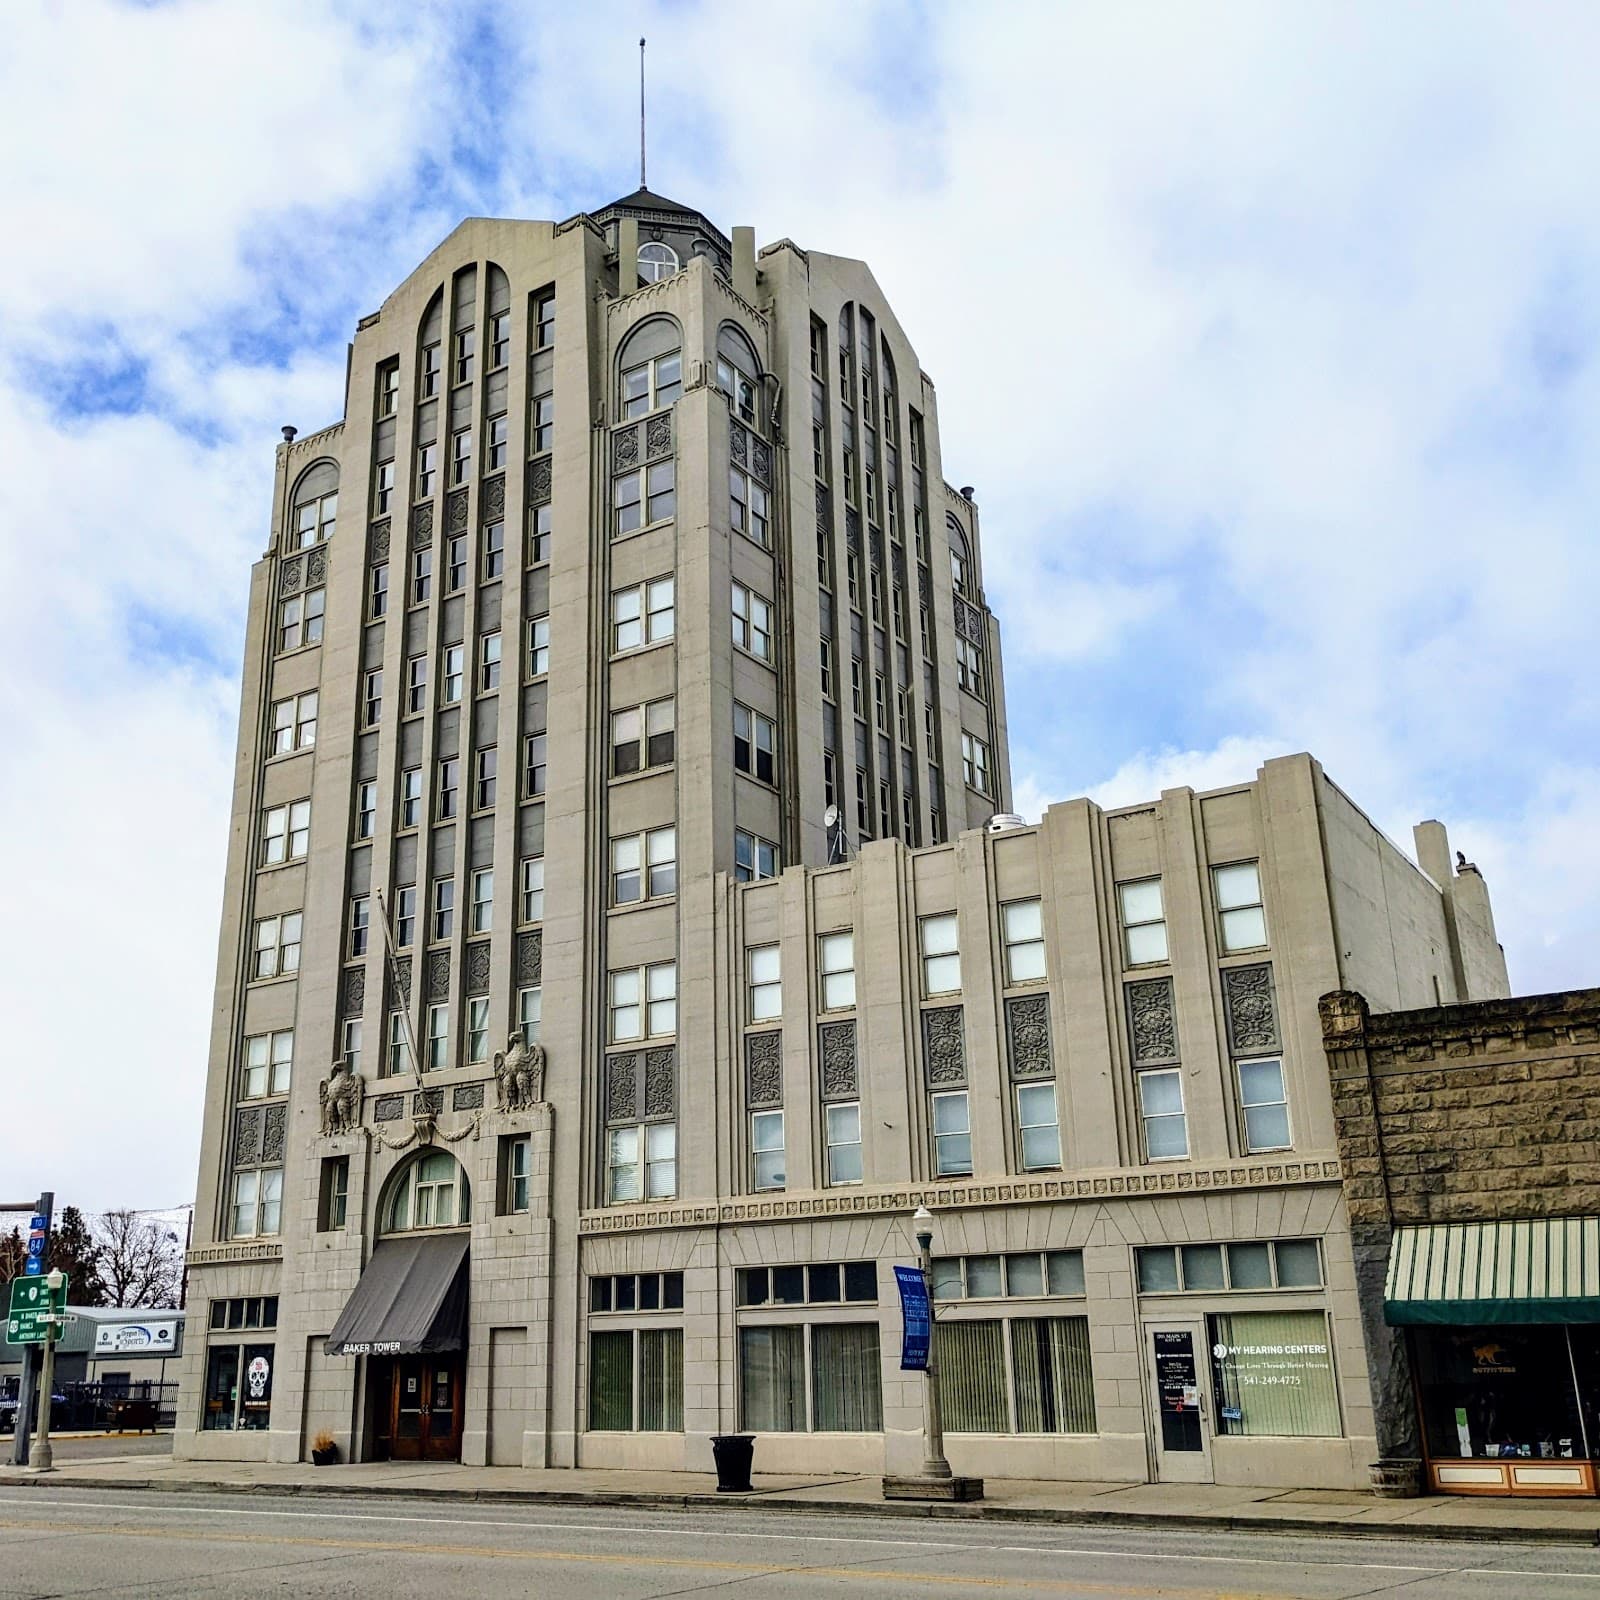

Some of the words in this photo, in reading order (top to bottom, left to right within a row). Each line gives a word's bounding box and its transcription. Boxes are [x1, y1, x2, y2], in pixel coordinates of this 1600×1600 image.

[30, 1239, 41, 1252] 84
[343, 1343, 370, 1353] BAKER
[373, 1341, 401, 1352] TOWER
[1229, 1346, 1242, 1355] MY
[1243, 1345, 1283, 1355] HEARING
[1284, 1344, 1327, 1354] CENTERS
[1263, 1362, 1286, 1370] Through
[1287, 1361, 1305, 1369] Better
[1305, 1361, 1329, 1370] Hearing
[1472, 1366, 1516, 1374] OUTFITTERS
[1244, 1375, 1300, 1385] 541-249-4775
